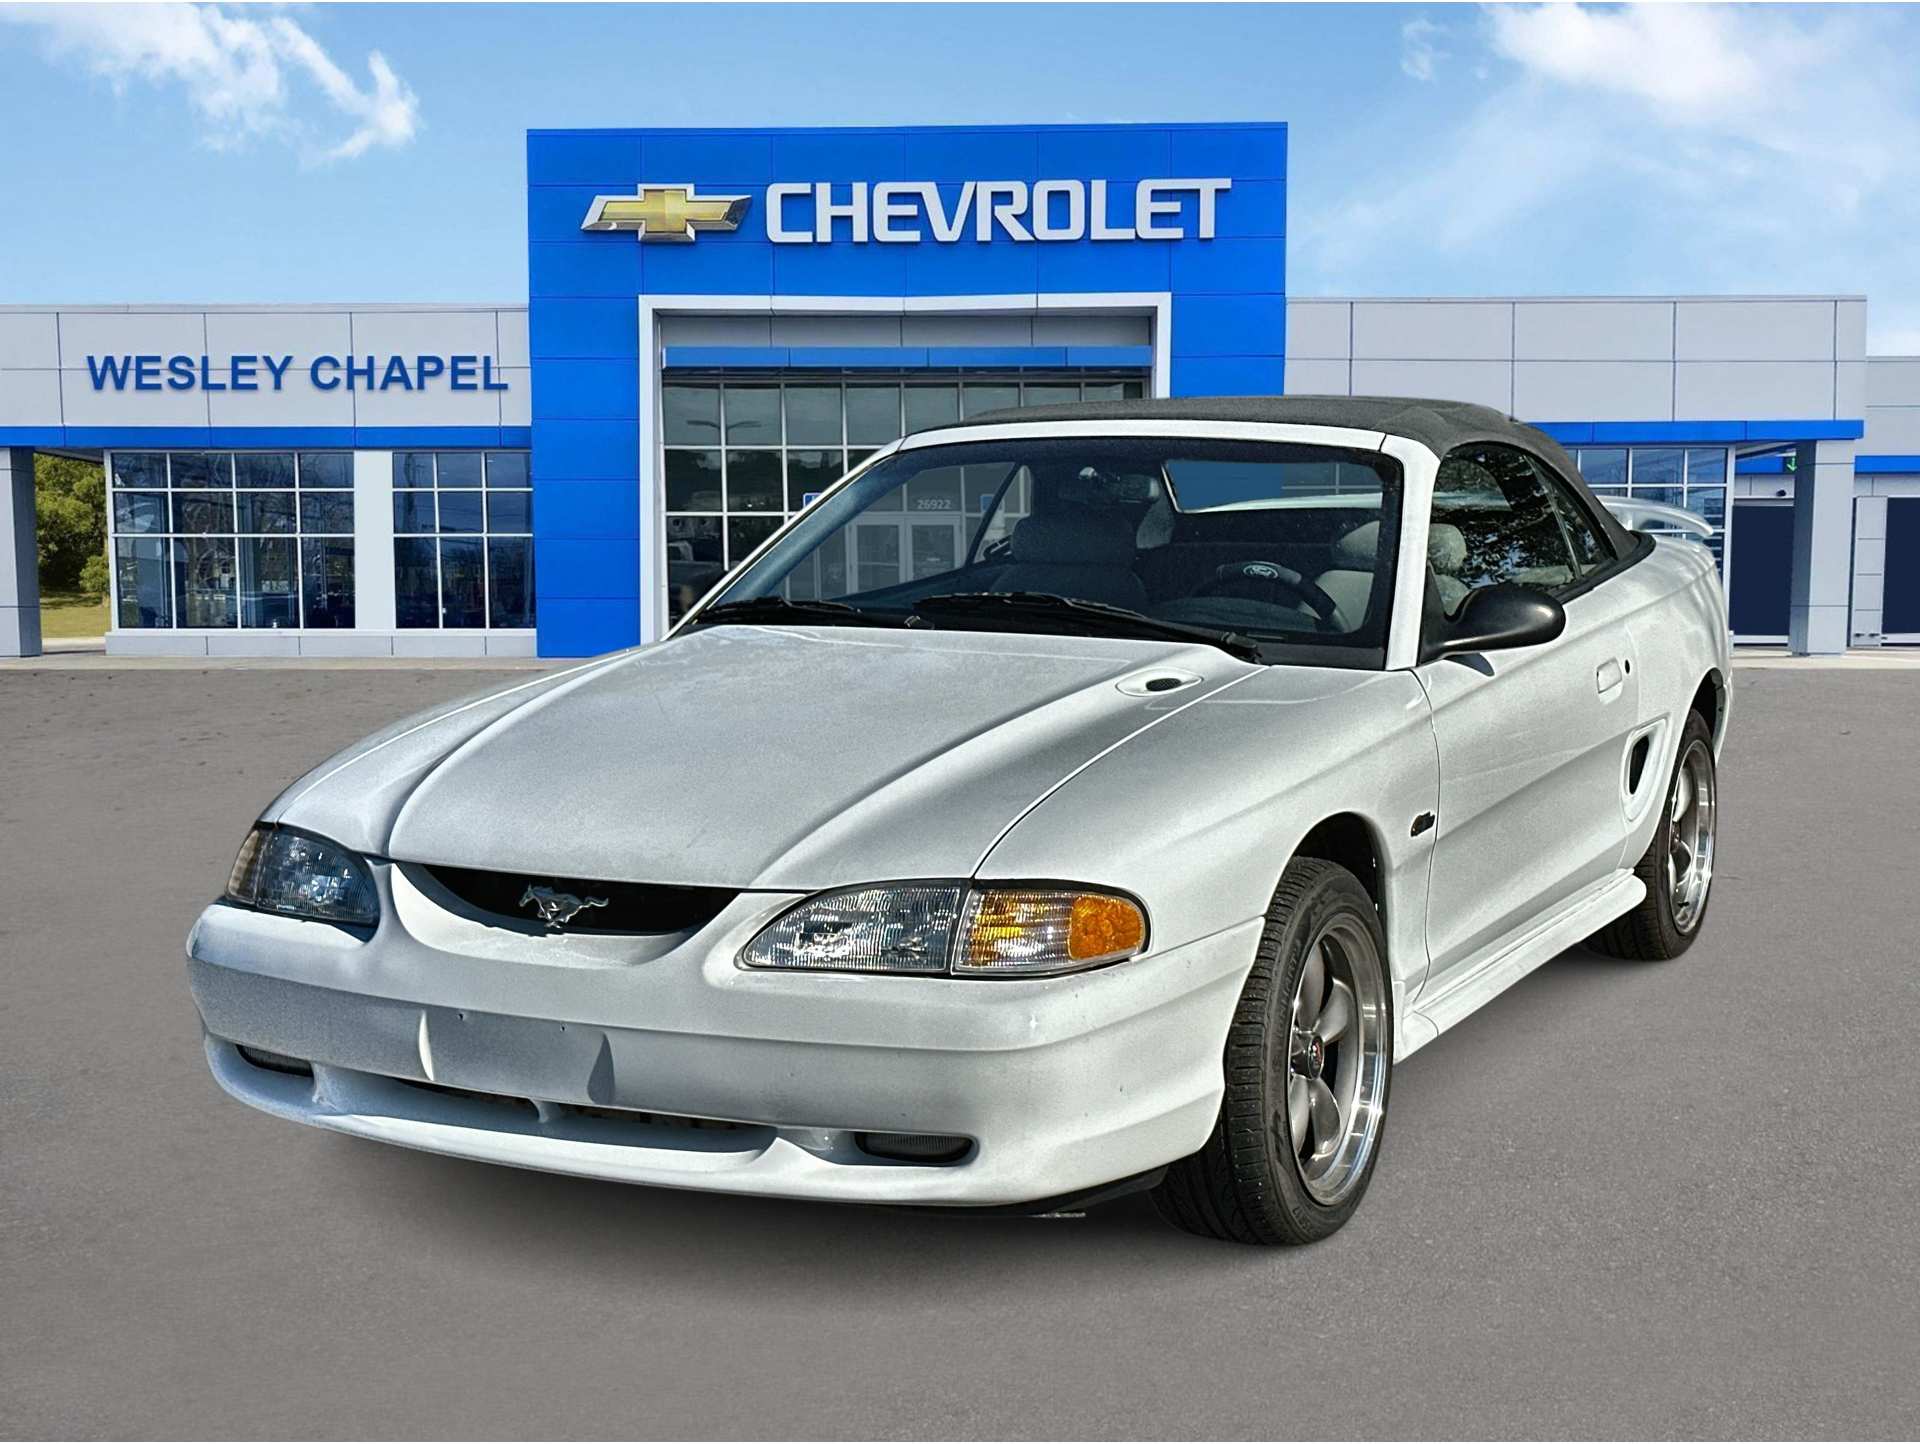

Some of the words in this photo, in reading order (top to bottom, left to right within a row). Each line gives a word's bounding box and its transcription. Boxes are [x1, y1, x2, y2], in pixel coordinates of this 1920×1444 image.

[766, 177, 1232, 243] CHEVROLET
[86, 355, 294, 391] WESLEY
[310, 355, 509, 391] CHAPEL
[917, 499, 951, 510] 26922
